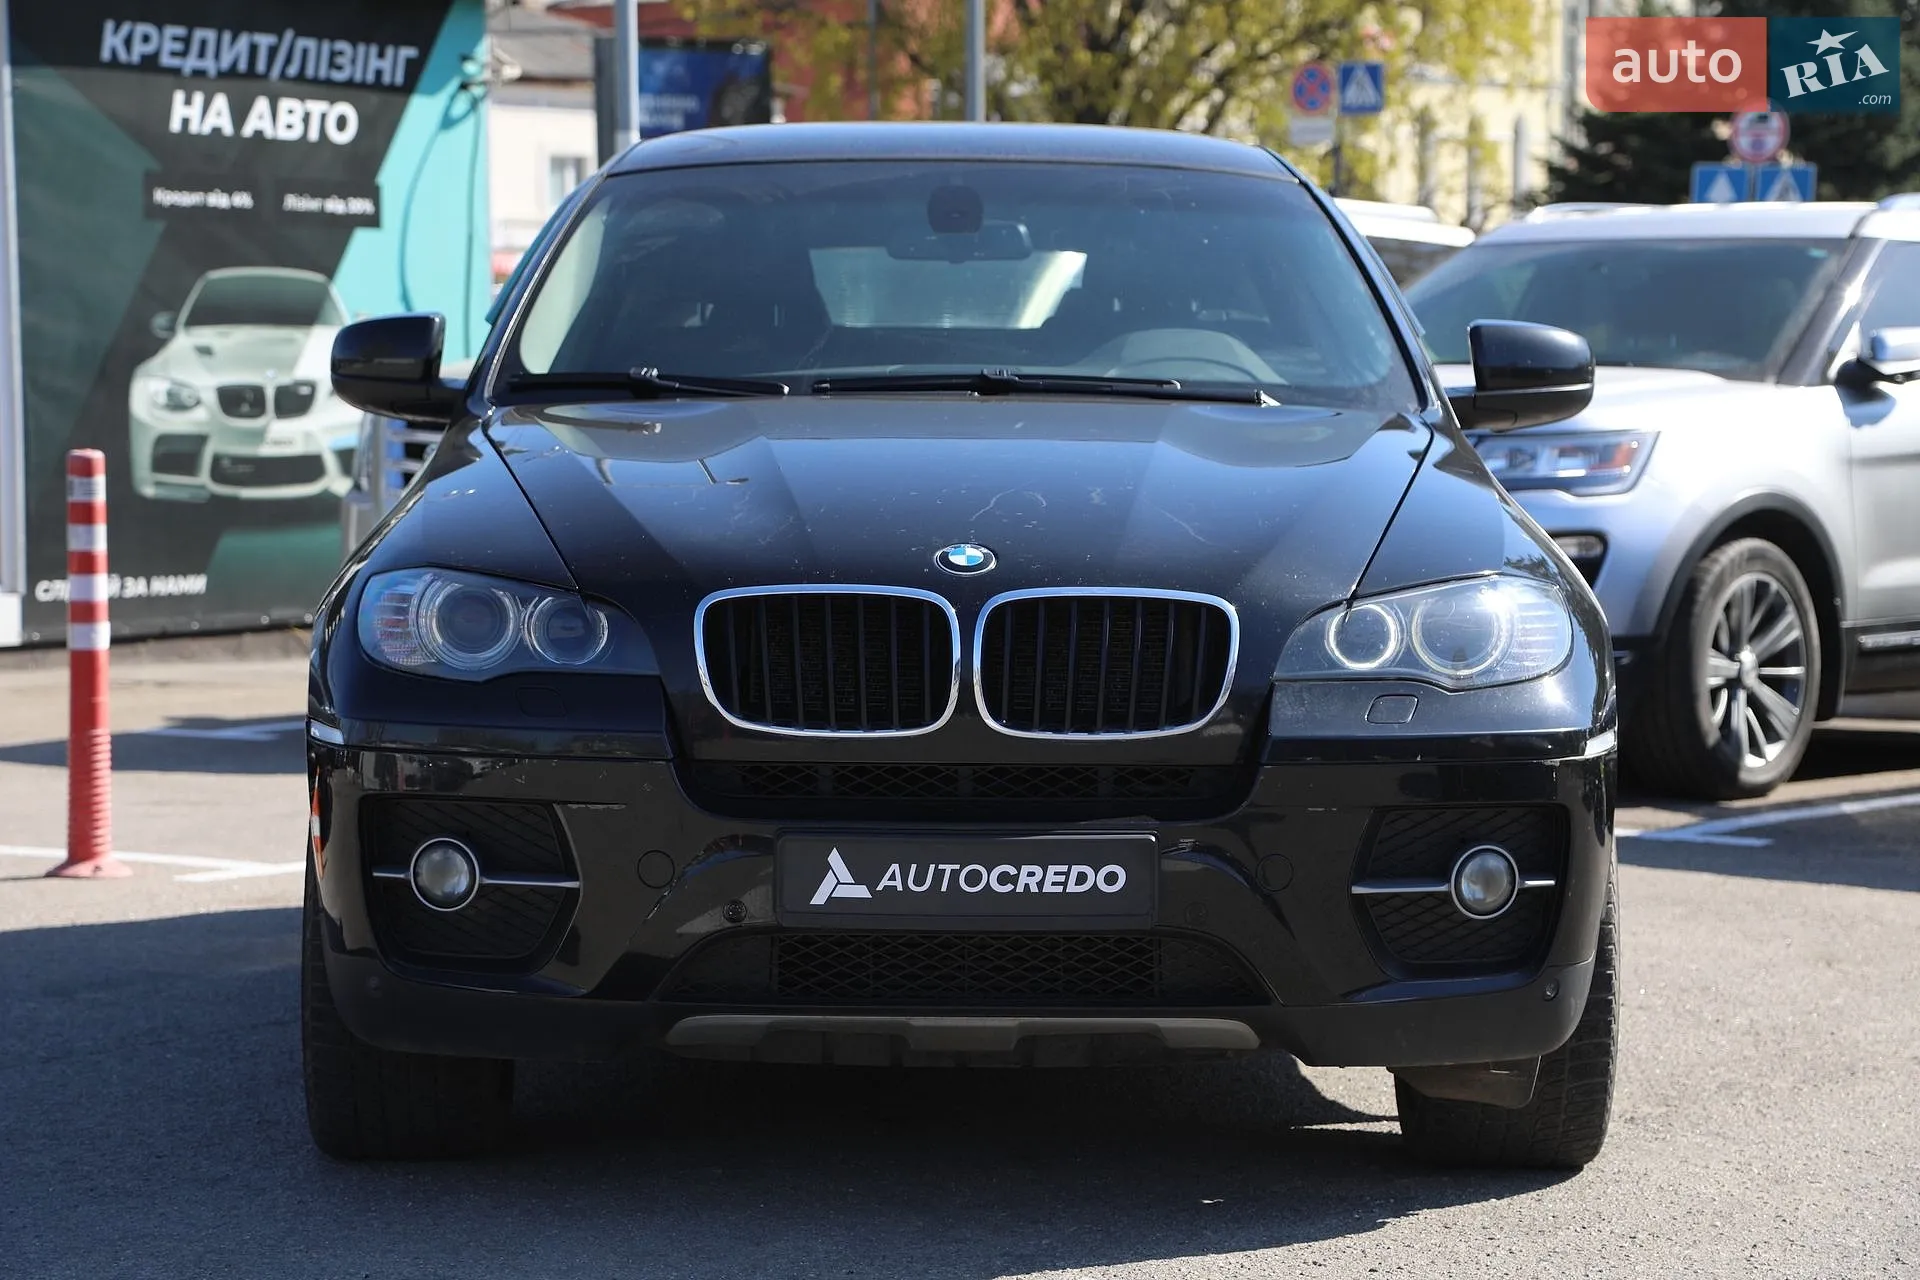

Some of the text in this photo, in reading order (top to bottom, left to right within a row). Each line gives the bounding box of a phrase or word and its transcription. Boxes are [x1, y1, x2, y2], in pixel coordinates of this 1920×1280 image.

[99, 19, 419, 87] КРЕДИТ/ЛІЗІНГ
[169, 89, 359, 145] НА АВТО
[121, 576, 148, 598] ЗА
[149, 574, 207, 597] НАМИ
[876, 863, 1127, 893] AUTOCREDO
